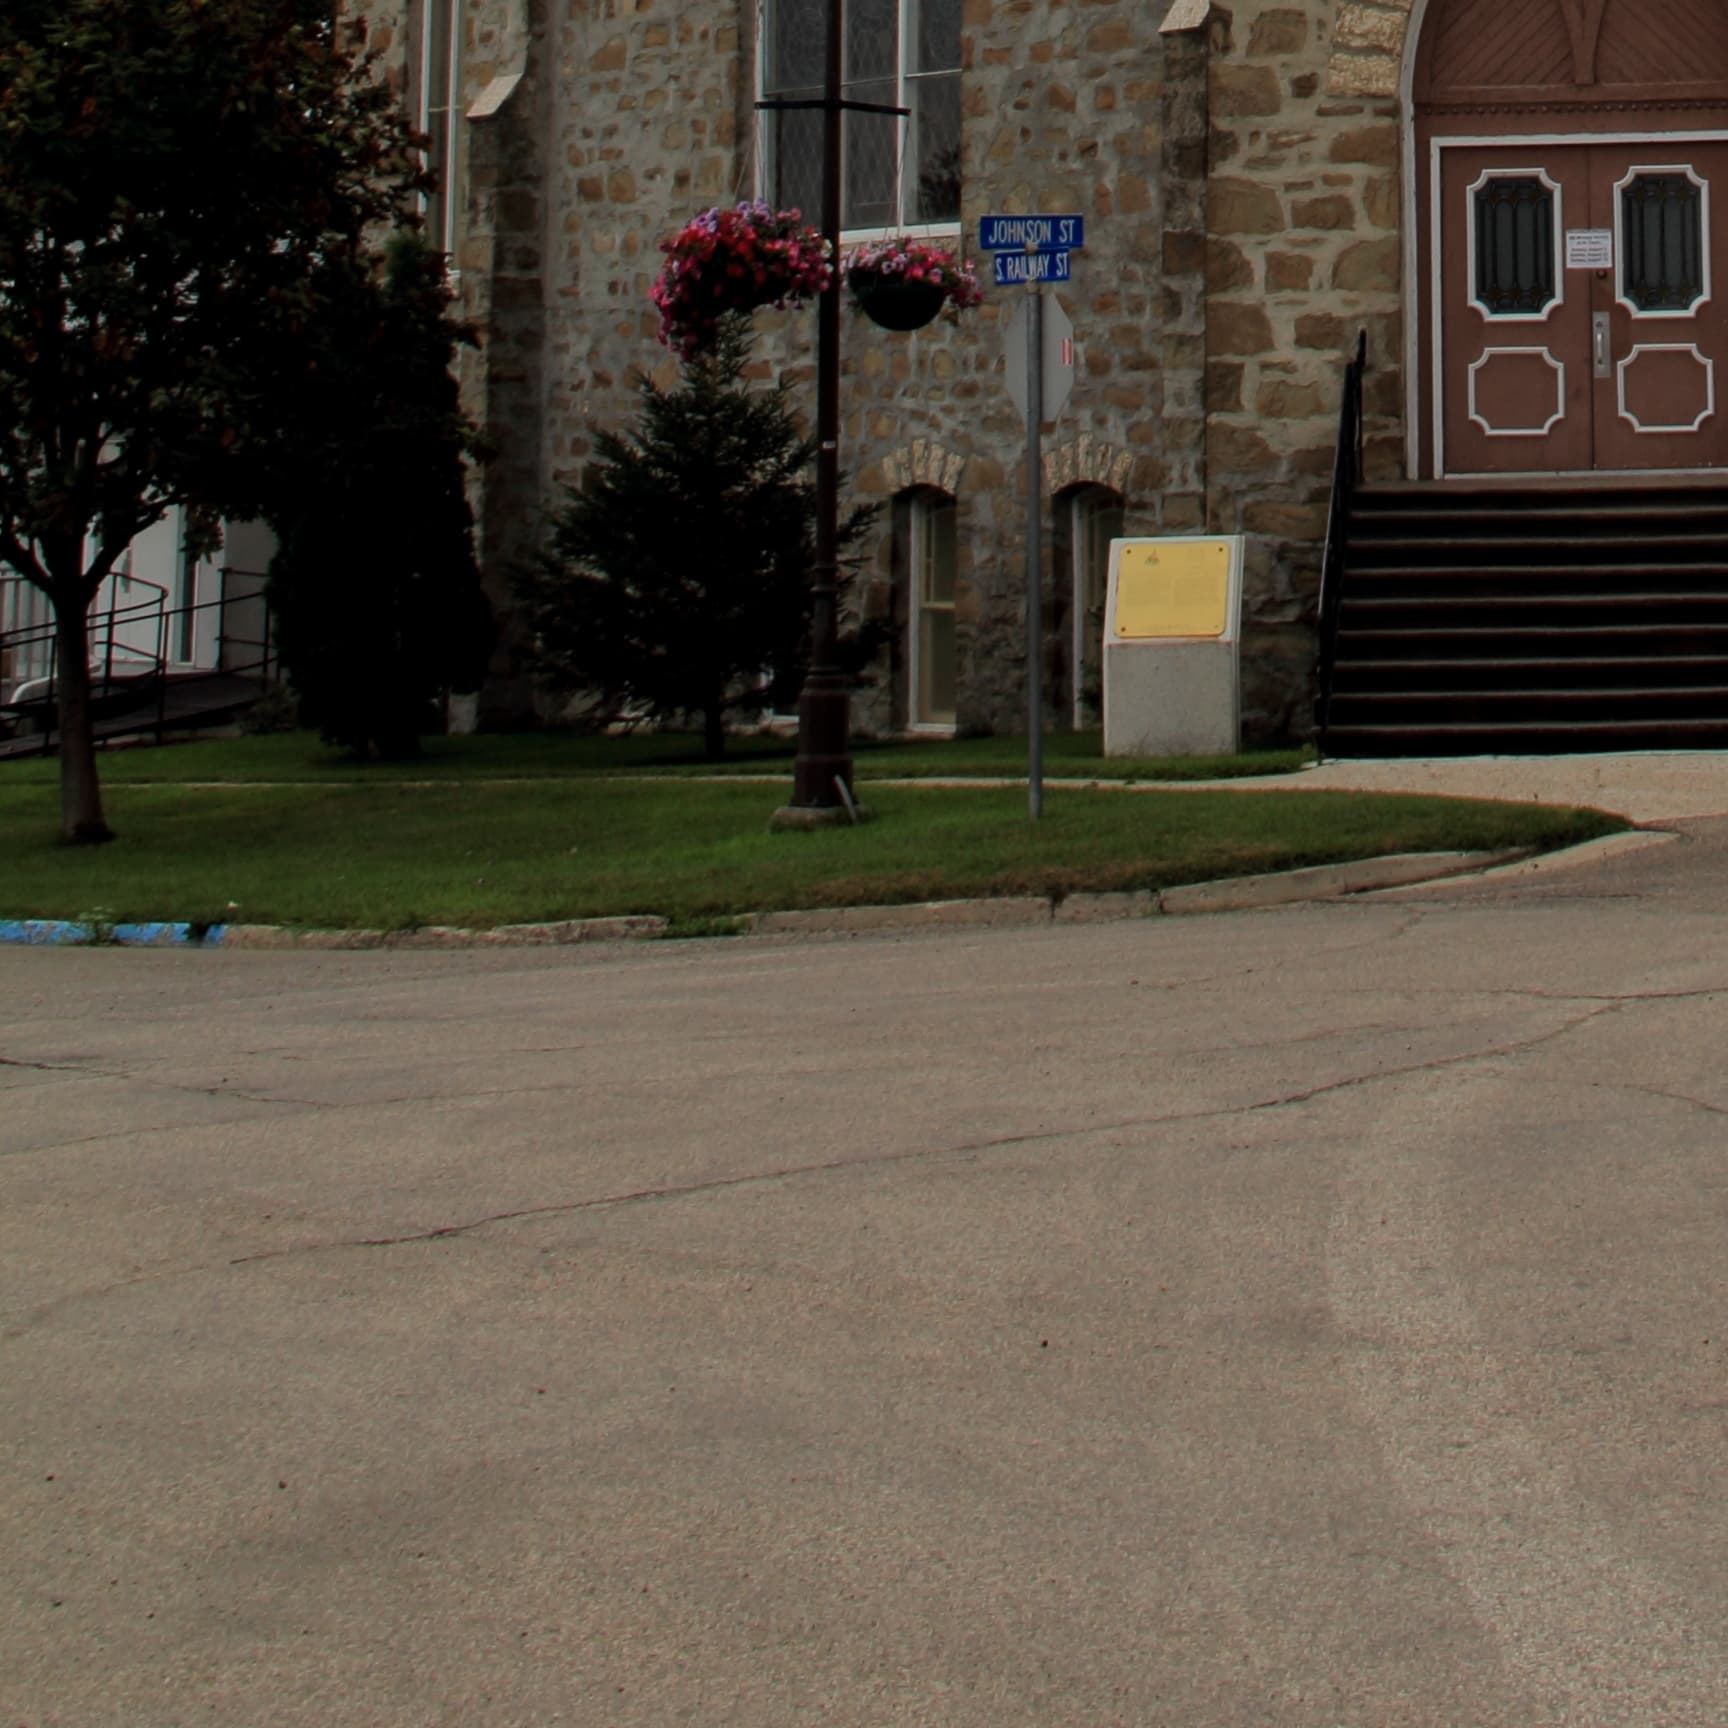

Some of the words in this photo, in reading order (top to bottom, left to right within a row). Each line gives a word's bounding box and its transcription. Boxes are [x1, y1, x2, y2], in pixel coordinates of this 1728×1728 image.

[988, 219, 1052, 244] JOHNSON
[1059, 219, 1076, 243] ST
[1007, 254, 1050, 280] RAILWAY
[1056, 252, 1068, 277] ST
